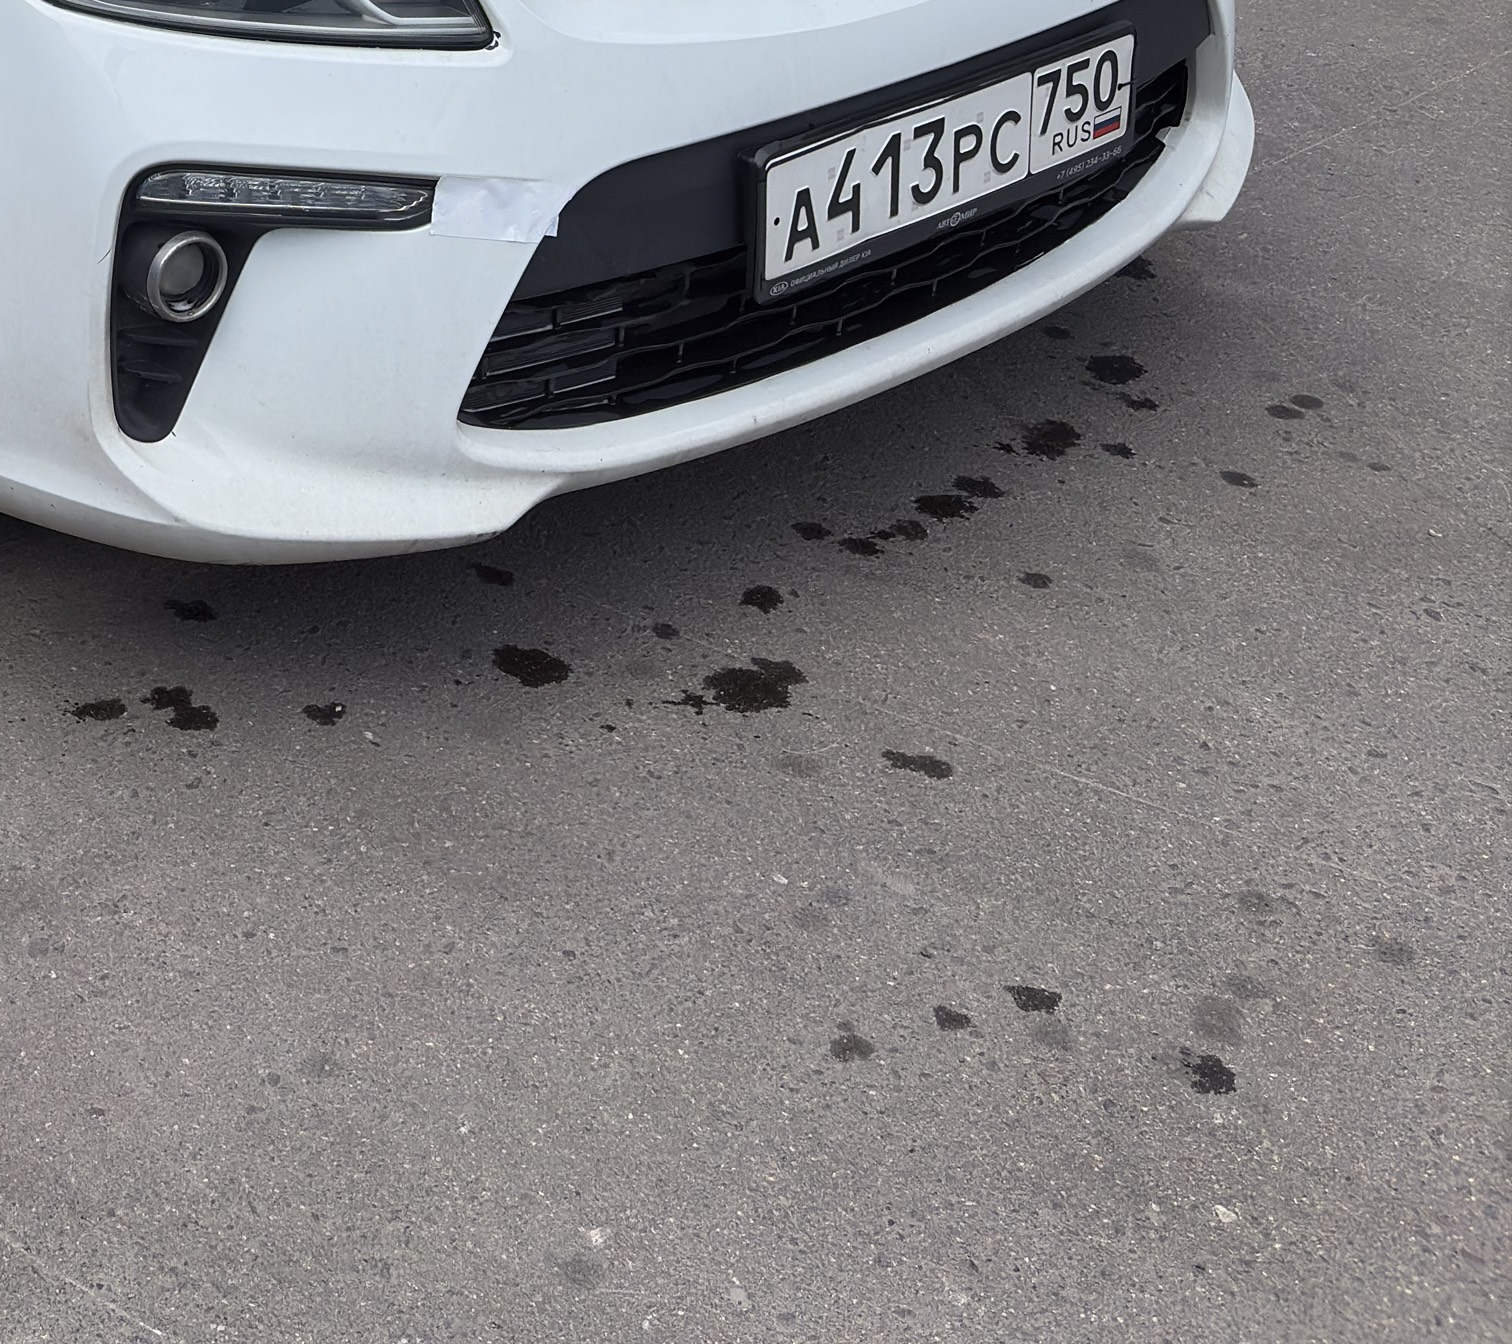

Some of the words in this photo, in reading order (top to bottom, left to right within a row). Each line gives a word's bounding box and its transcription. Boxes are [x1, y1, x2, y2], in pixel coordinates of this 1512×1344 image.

[1037, 49, 1120, 137] 750
[1051, 120, 1092, 156] RUS
[771, 282, 788, 295] KIA
